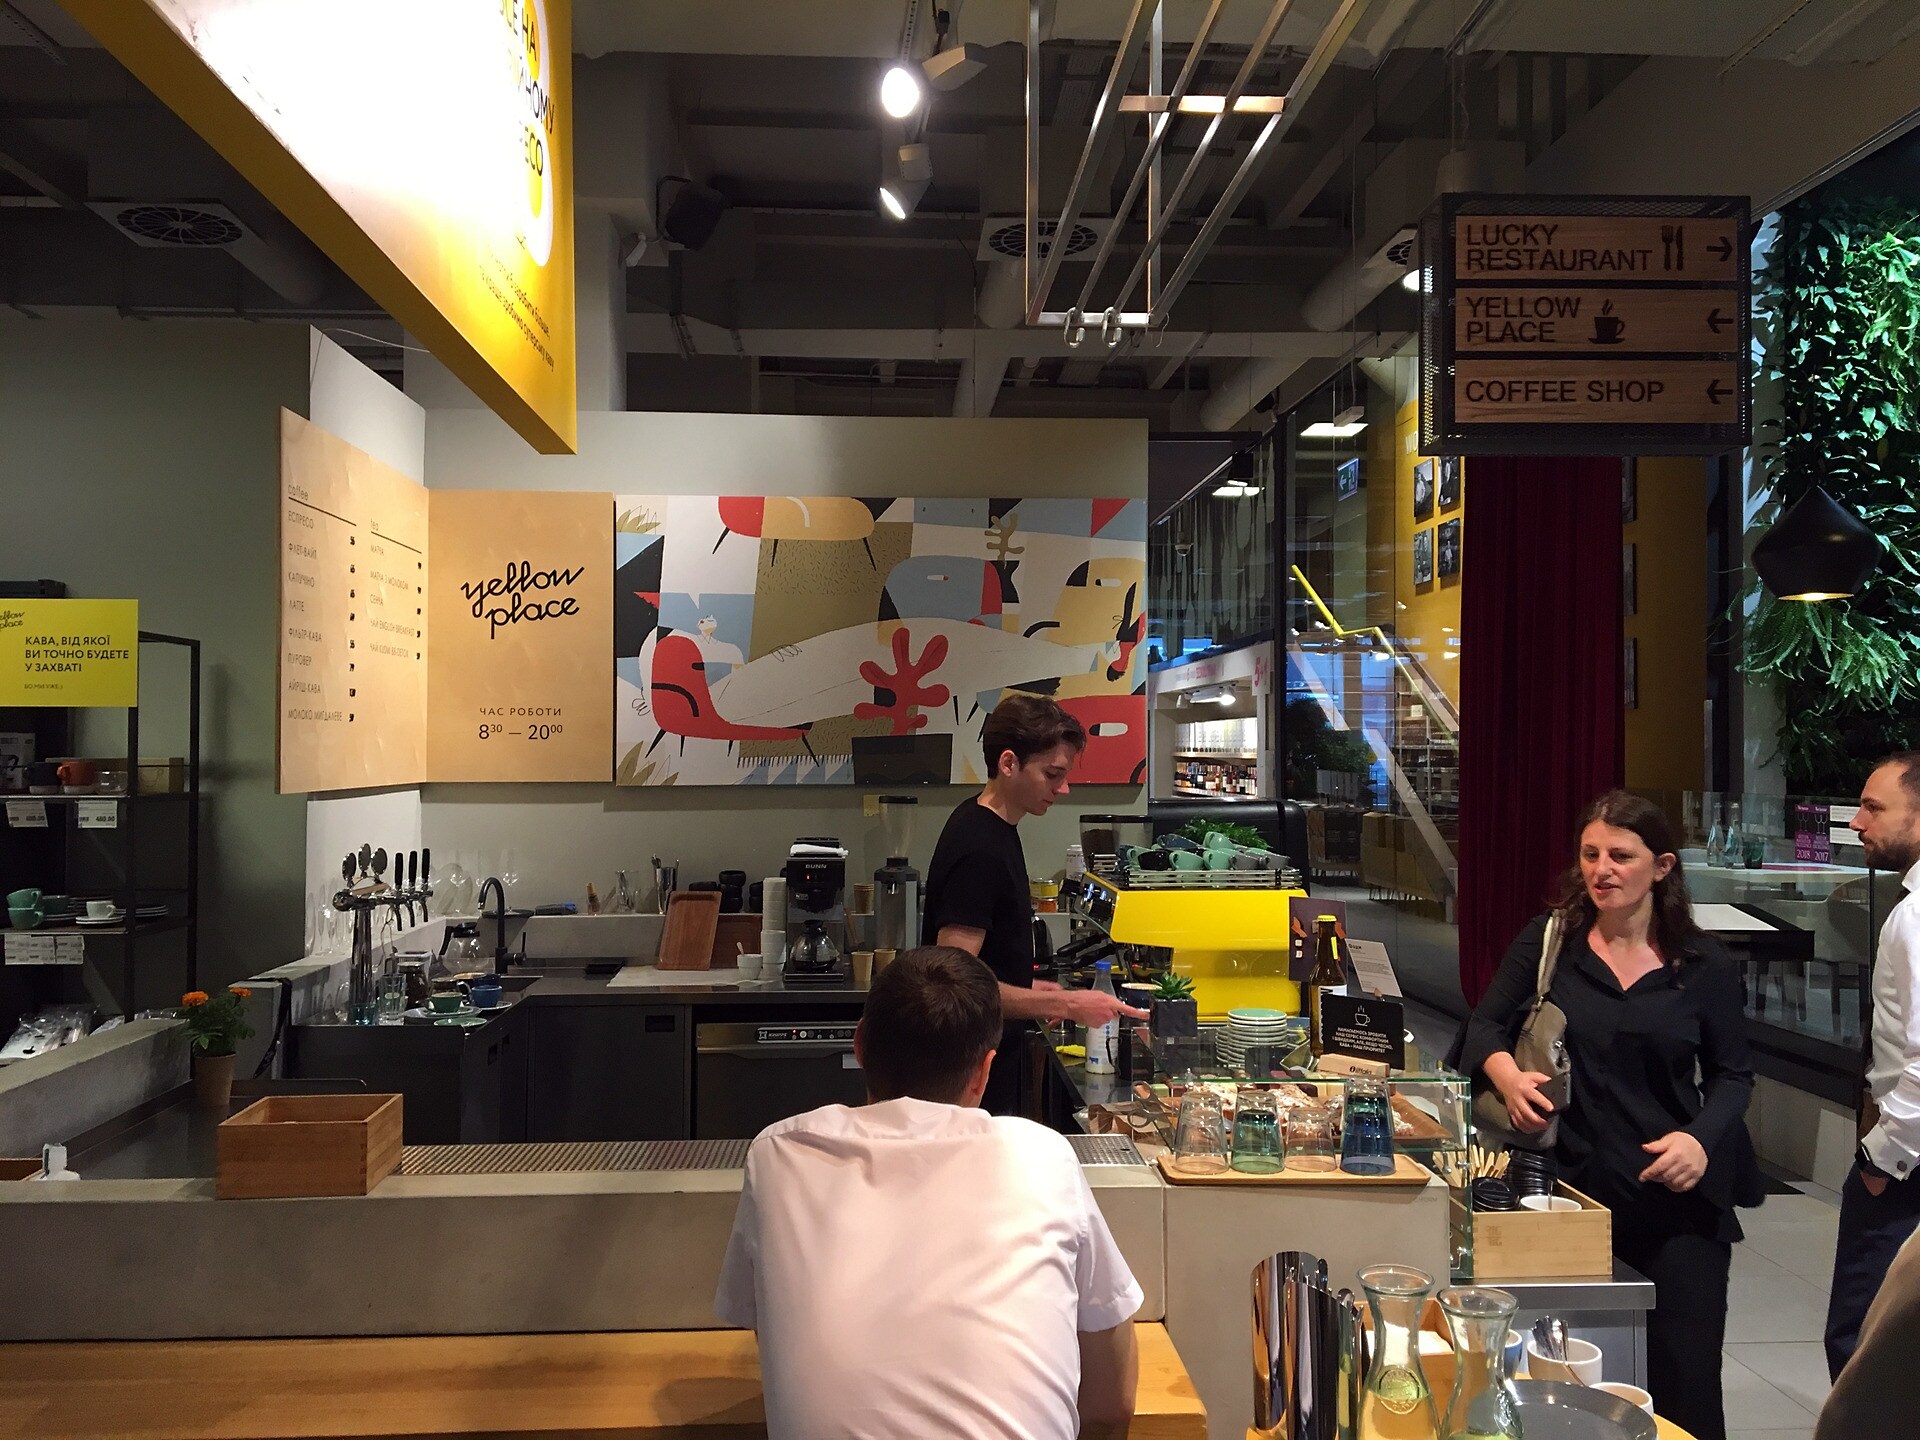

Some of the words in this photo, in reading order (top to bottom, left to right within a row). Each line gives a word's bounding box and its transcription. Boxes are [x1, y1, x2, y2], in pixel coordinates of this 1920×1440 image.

[1466, 224, 1558, 246] LUCKY
[1466, 249, 1653, 271] RESTAURANT
[1466, 296, 1581, 319] YELLOW
[1466, 321, 1556, 343] PLACE
[1465, 380, 1577, 403] COFFEE
[1587, 380, 1665, 403] SHOP
[288, 484, 309, 501] coffee
[288, 510, 315, 529] ЕСПРЕСО
[288, 542, 317, 560] ФЛЕТ-ВАЙТ
[460, 560, 585, 618] yellow
[484, 592, 580, 640] place
[25, 636, 59, 647] КАВА,
[61, 636, 81, 647] ВІД
[83, 635, 111, 646] ЯКОЇ
[25, 649, 41, 659] ВИ
[43, 649, 84, 659] ТОЧНО
[87, 649, 129, 660] БУДЕТЕ
[24, 662, 33, 672] У
[35, 663, 82, 672] ЗАХВАТІ
[479, 707, 504, 716] ЧАС
[509, 707, 562, 716] РОБОТИ
[1796, 849, 1811, 860] 2018
[1814, 851, 1829, 862] 2017
